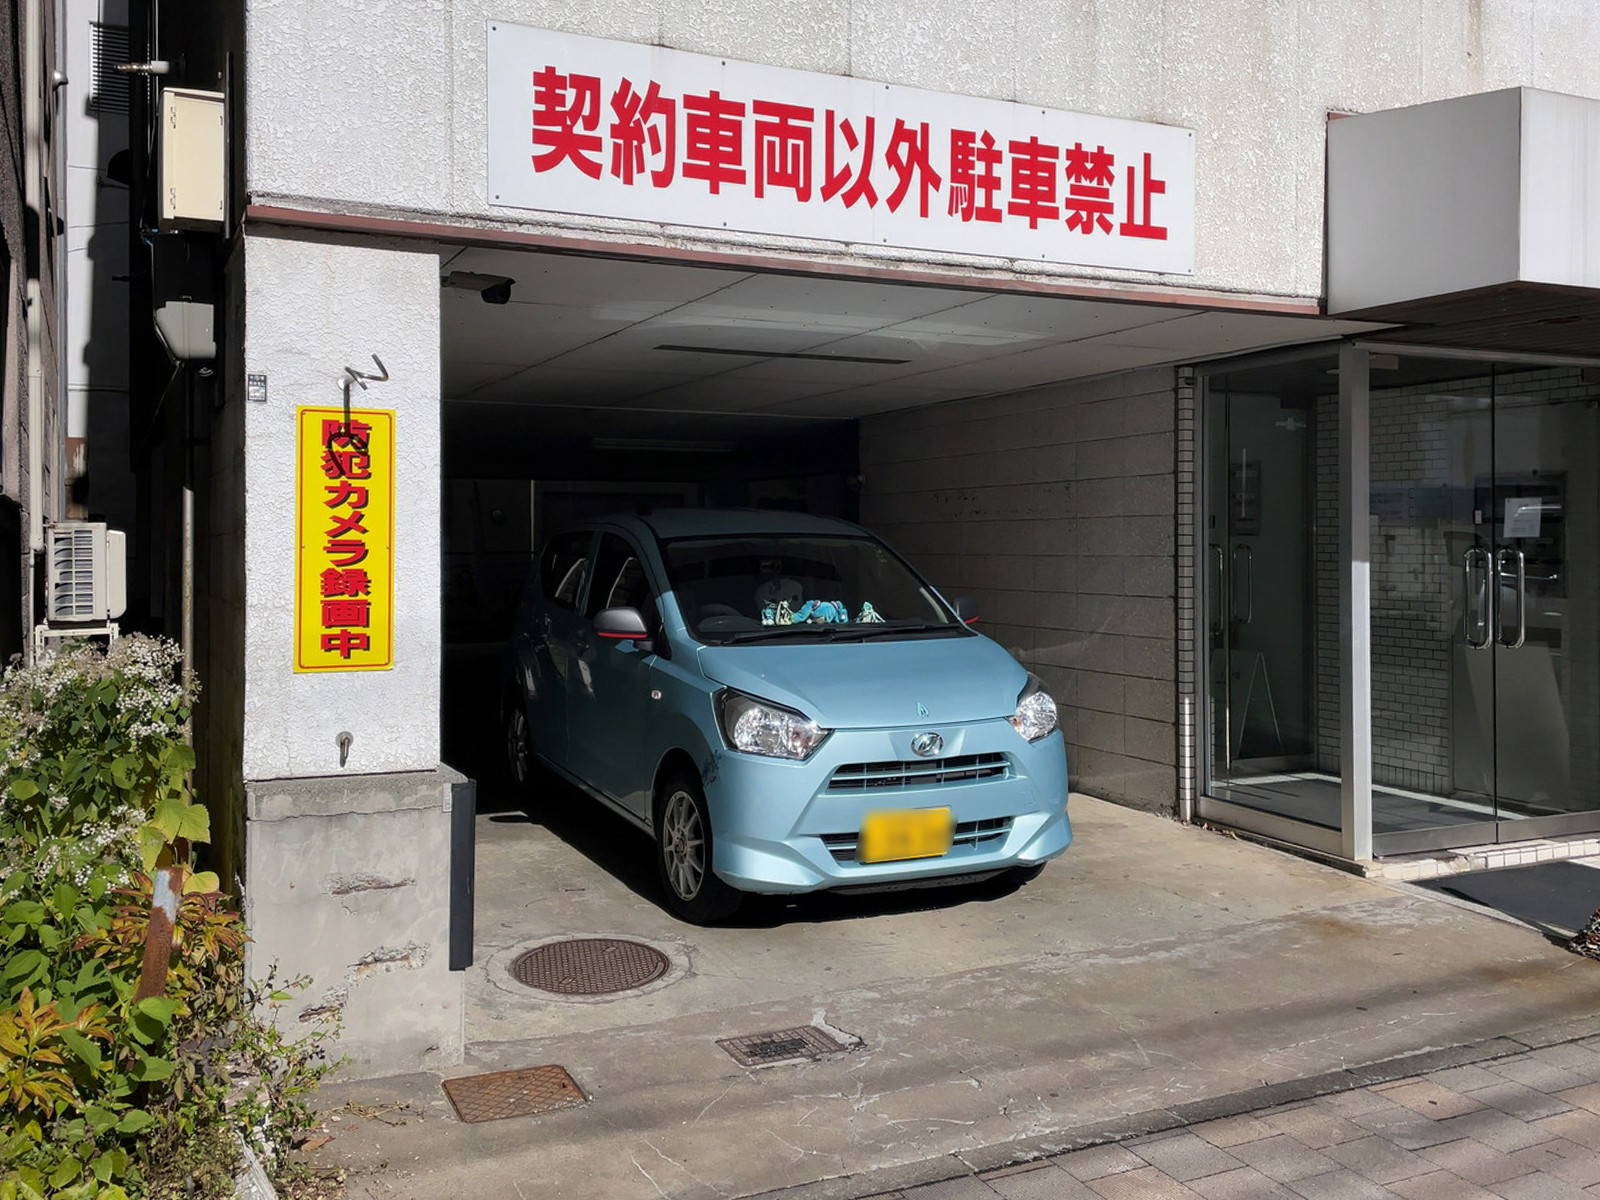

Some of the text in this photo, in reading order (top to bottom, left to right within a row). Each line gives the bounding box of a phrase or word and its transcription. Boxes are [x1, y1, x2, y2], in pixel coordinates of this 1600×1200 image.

[532, 66, 1167, 241] 契約車両以外駐車禁止
[320, 418, 372, 659] 防犯カメラ録画中
